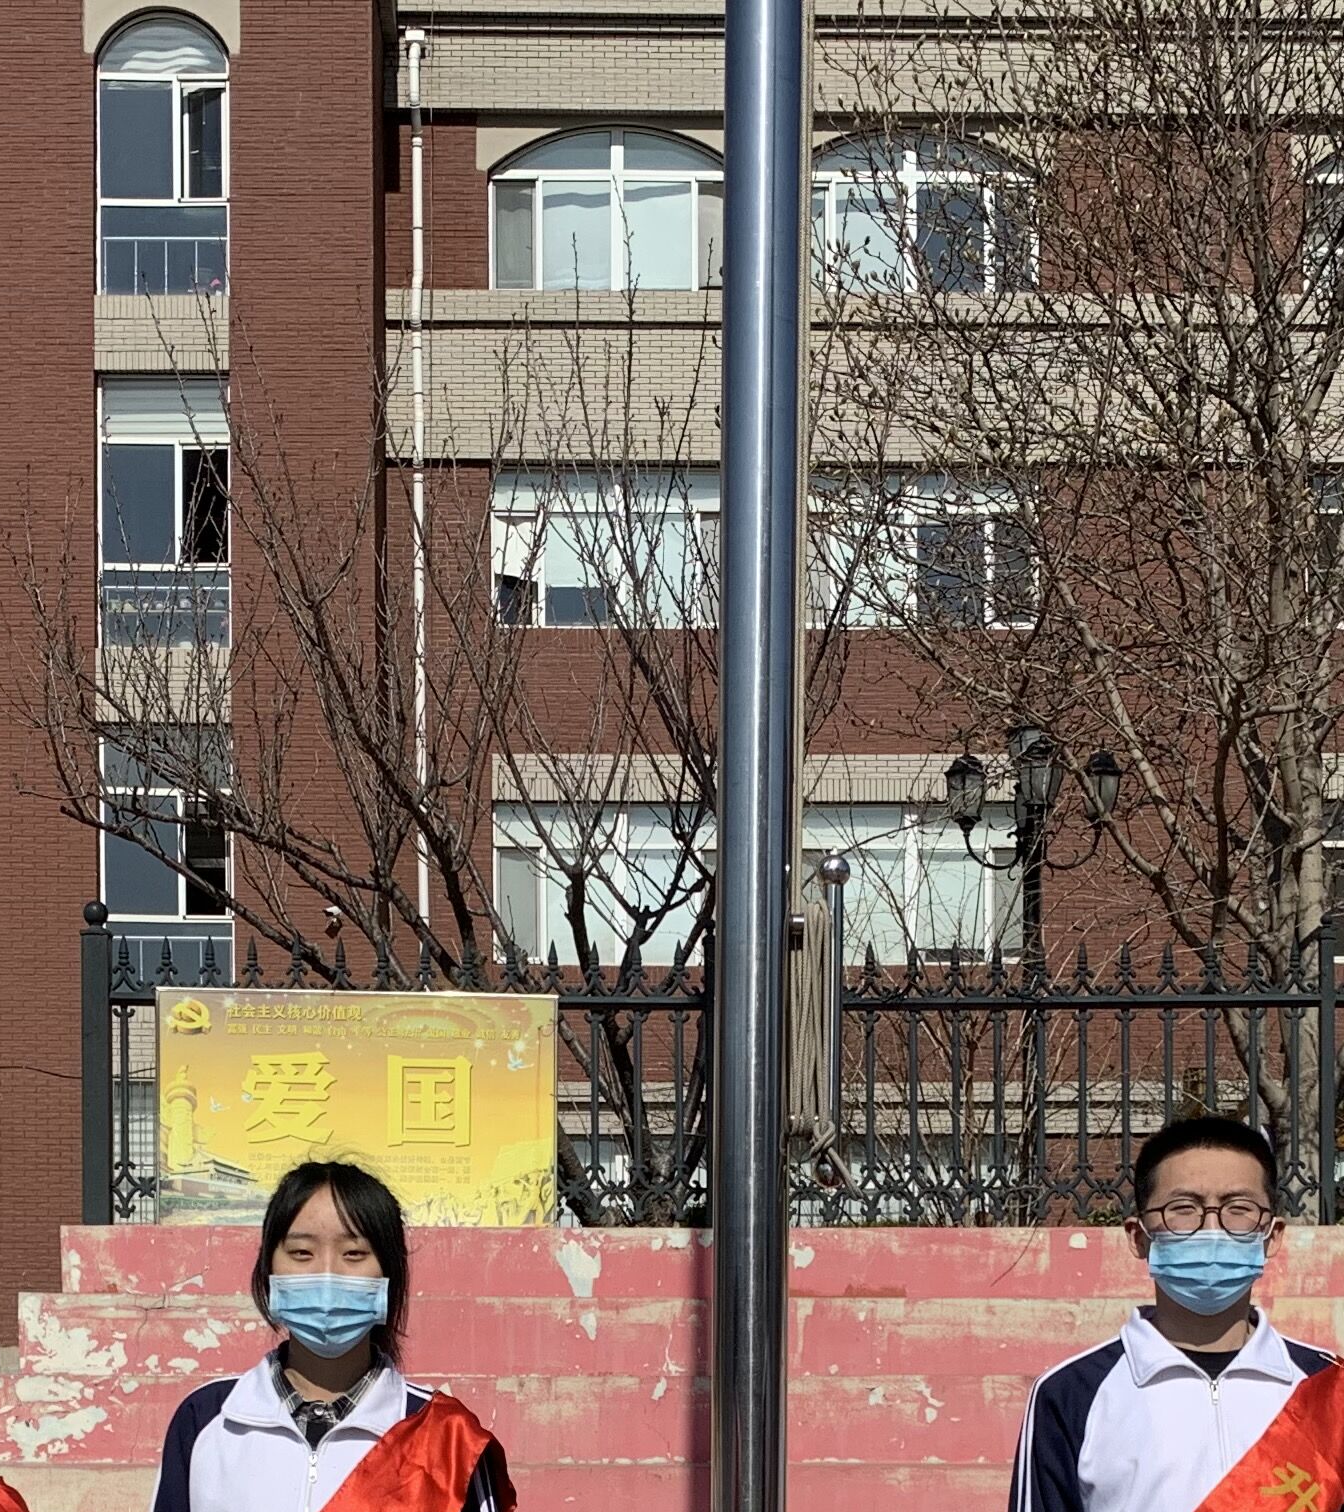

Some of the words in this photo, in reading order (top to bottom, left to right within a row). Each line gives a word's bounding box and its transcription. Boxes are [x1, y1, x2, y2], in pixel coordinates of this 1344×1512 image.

[226, 1003, 362, 1022] 社会主义核心价值观
[241, 1051, 473, 1148] 爱国
